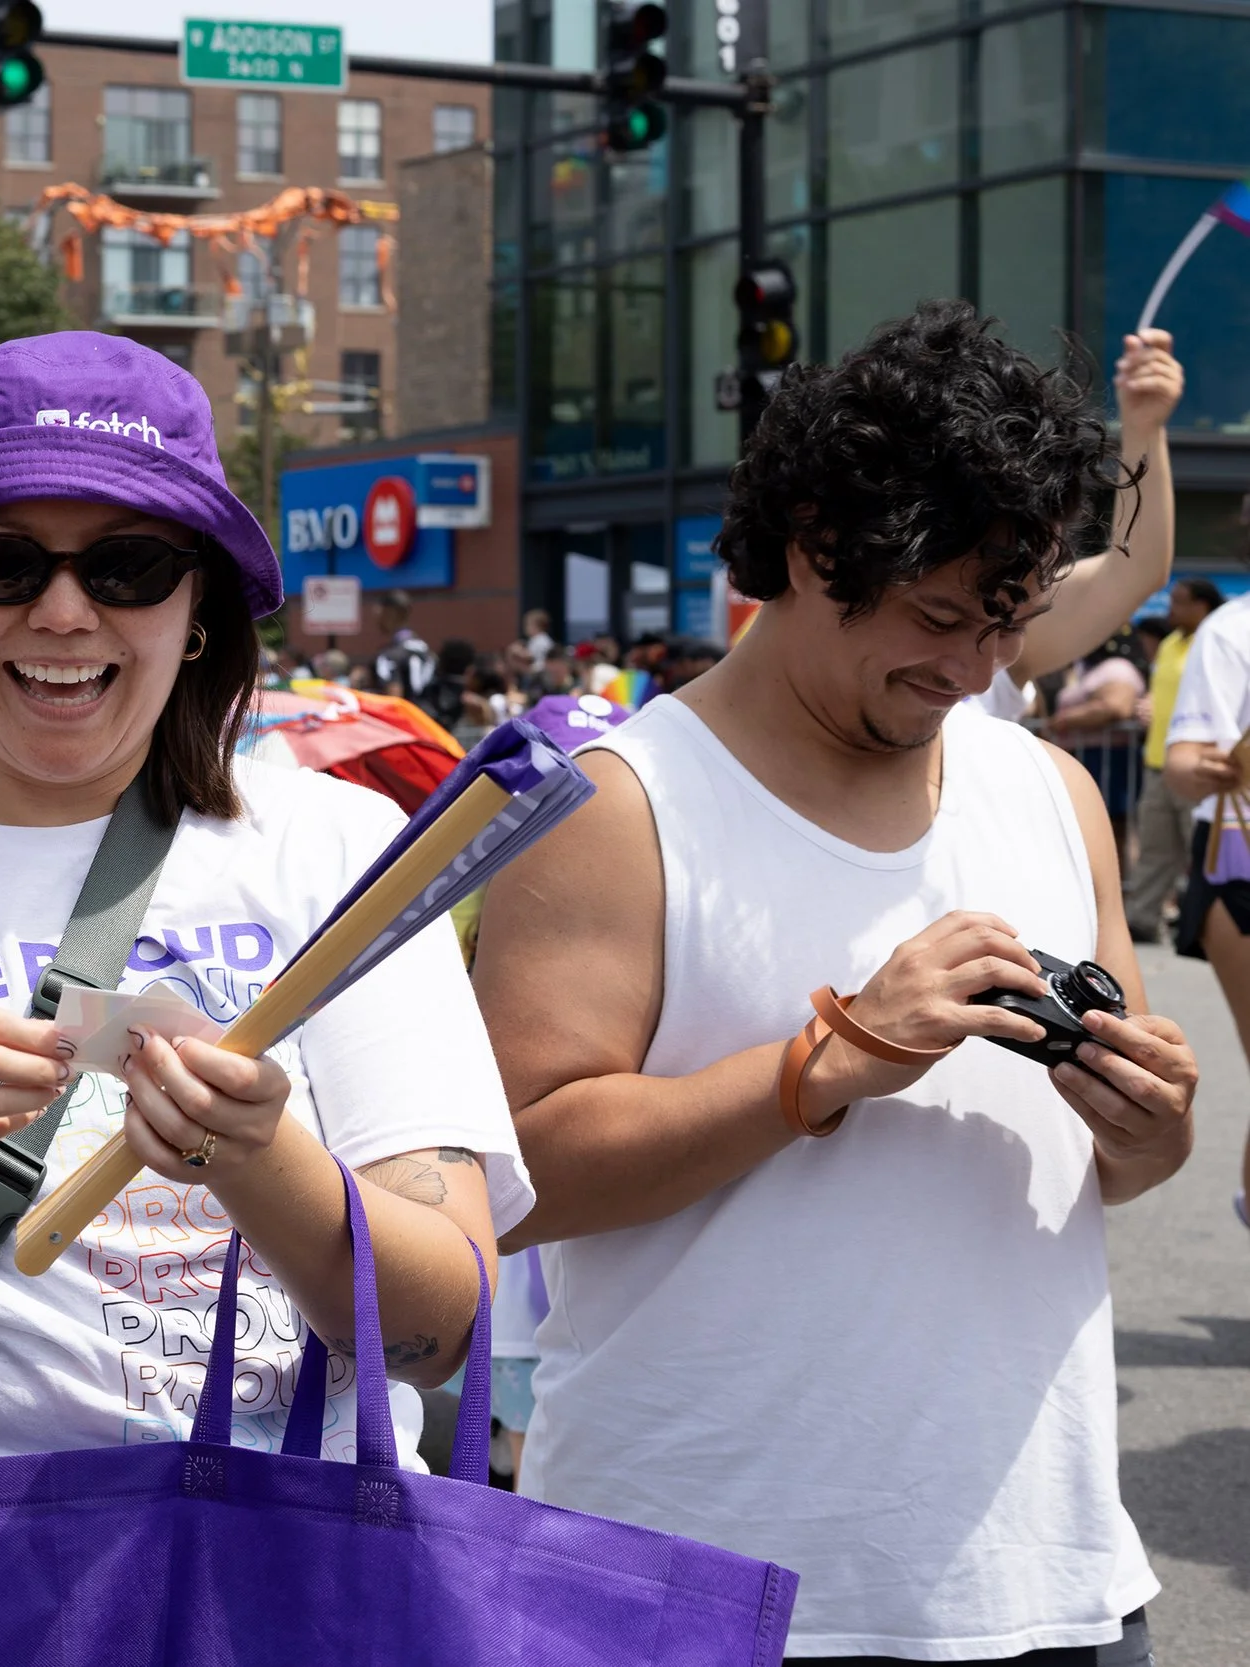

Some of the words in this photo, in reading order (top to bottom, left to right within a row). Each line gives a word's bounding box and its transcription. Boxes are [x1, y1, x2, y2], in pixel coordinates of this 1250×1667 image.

[210, 23, 314, 57] ADDISON
[318, 35, 338, 54] ST
[288, 60, 304, 79] N
[20, 921, 275, 1001] POUD
[79, 1183, 236, 1253] PRO
[88, 1240, 273, 1313] PRO
[102, 1285, 310, 1357] PROU
